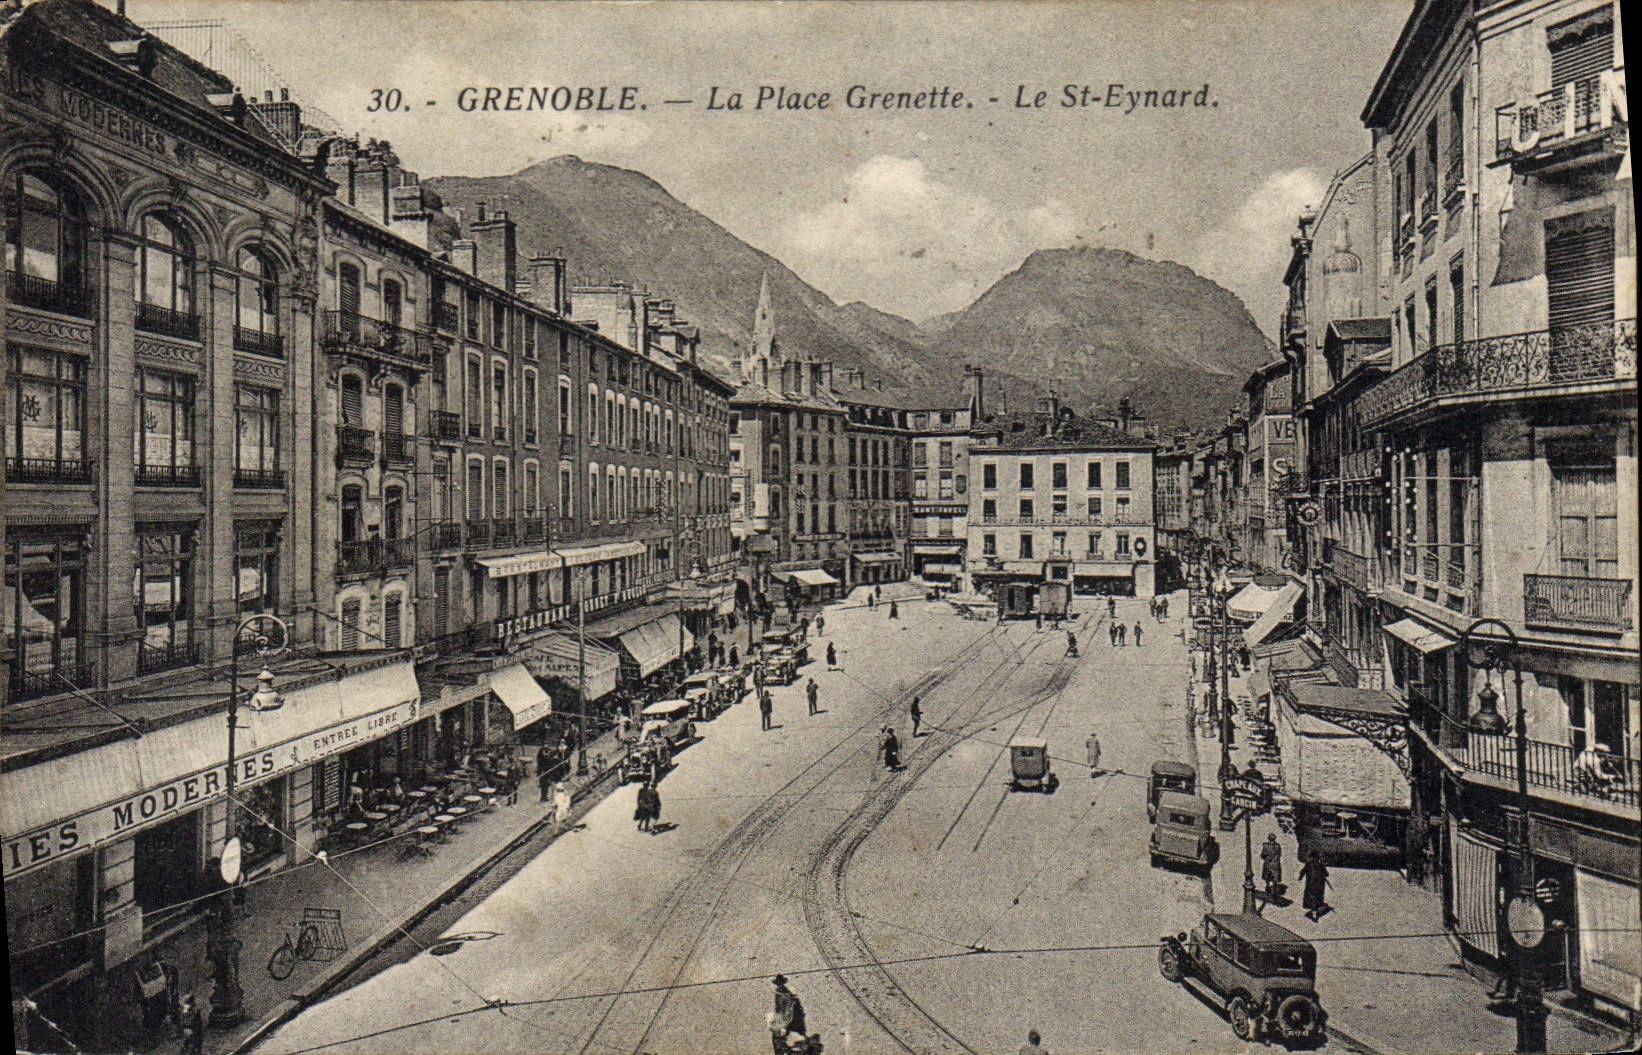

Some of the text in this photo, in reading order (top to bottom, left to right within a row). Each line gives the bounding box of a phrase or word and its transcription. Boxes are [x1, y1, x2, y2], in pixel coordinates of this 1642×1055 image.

[60, 87, 166, 155] MODERNES
[313, 710, 398, 752] ENTREE LIBRE
[10, 751, 275, 871] IES MODERNES
